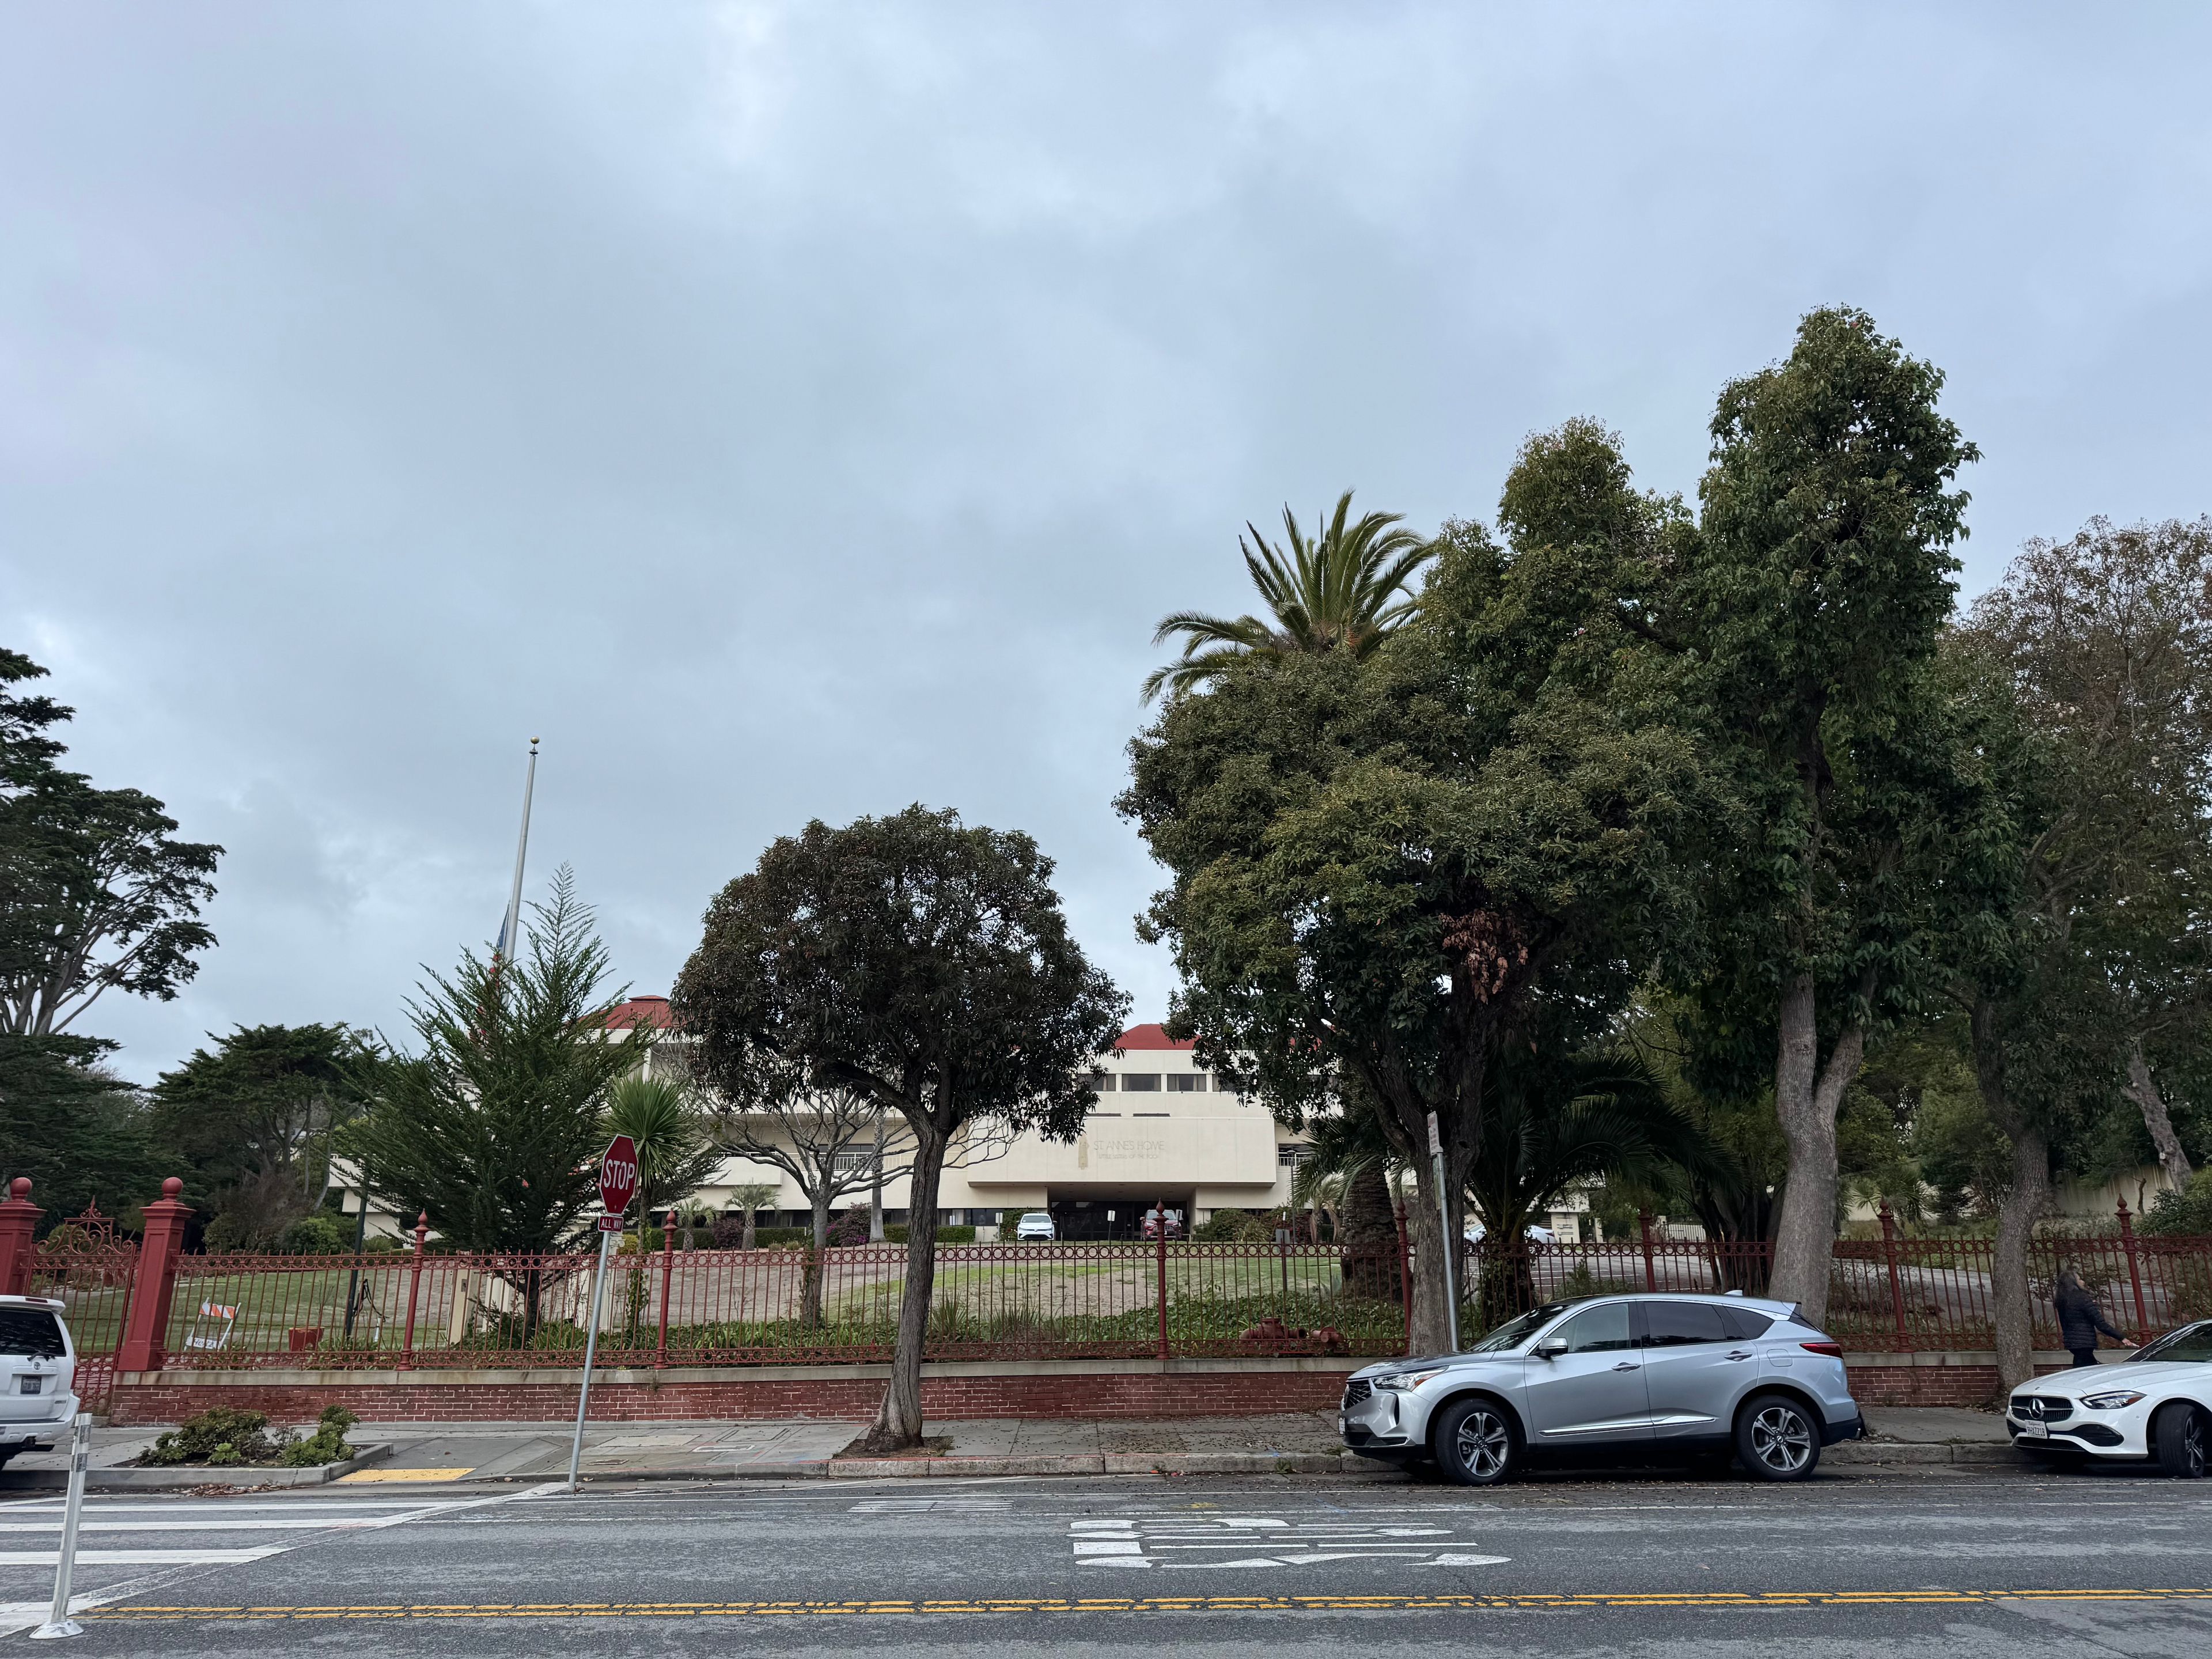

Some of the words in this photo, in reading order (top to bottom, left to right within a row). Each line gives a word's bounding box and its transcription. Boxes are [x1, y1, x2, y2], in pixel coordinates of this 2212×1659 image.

[1137, 1140, 1165, 1150] HOME
[604, 1159, 635, 1190] STOP
[601, 1219, 611, 1228] ALL
[613, 1219, 622, 1229] WAY
[1066, 1518, 1512, 1569] STOP
